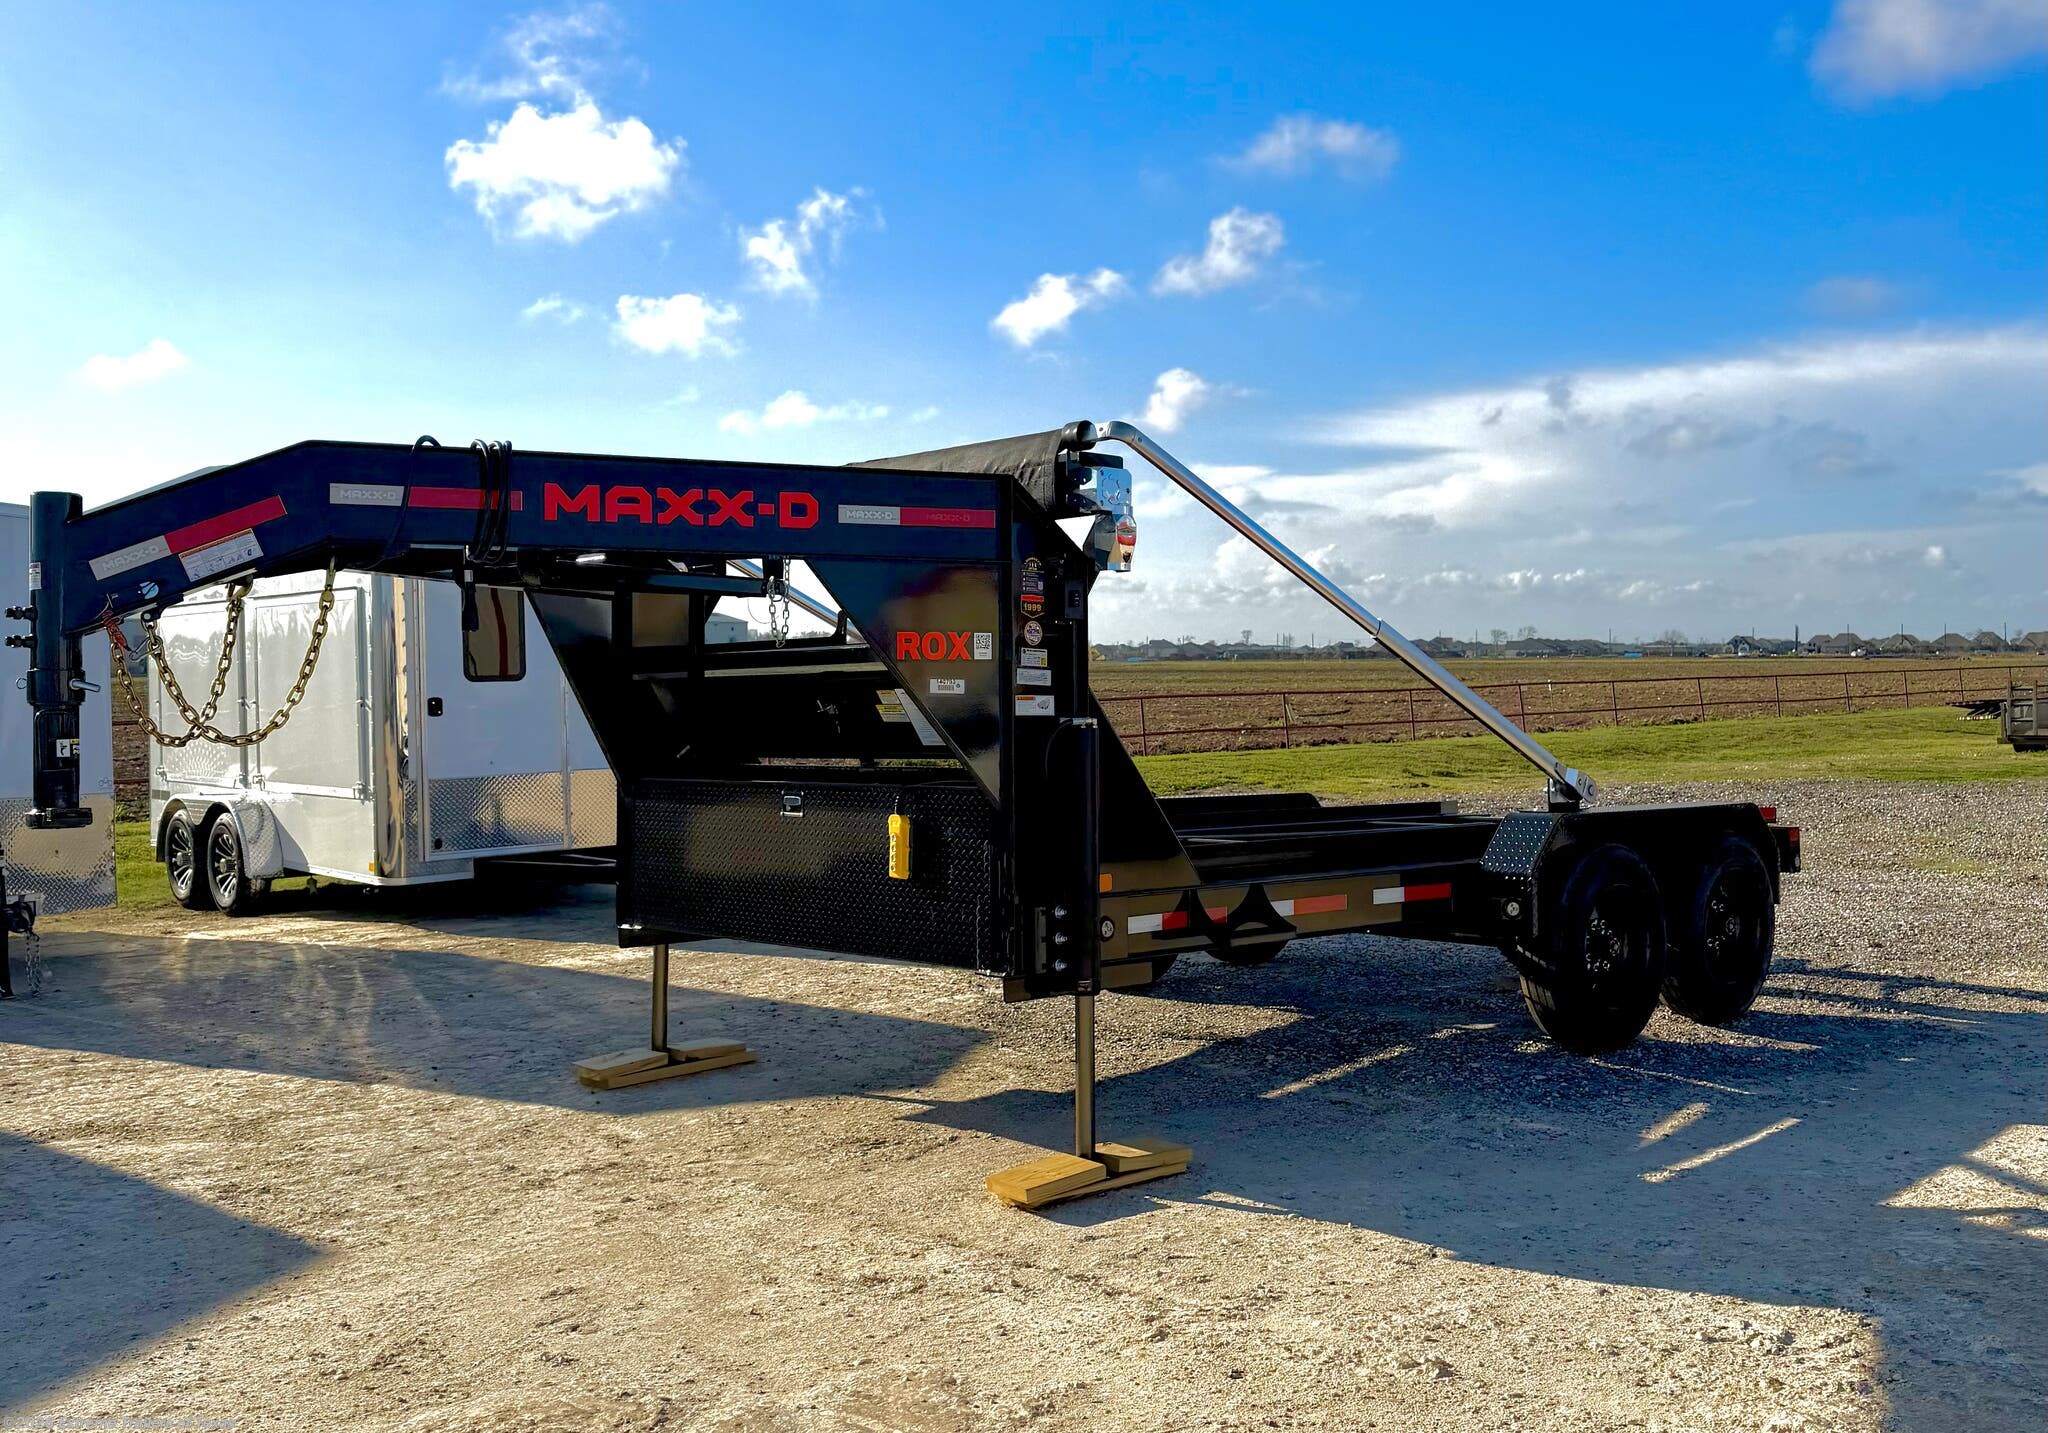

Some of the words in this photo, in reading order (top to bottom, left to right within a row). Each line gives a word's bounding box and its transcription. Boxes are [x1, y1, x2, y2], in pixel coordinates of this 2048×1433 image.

[544, 482, 819, 529] MAXX-D
[1024, 603, 1042, 612] 1999
[896, 631, 972, 660] ROX
